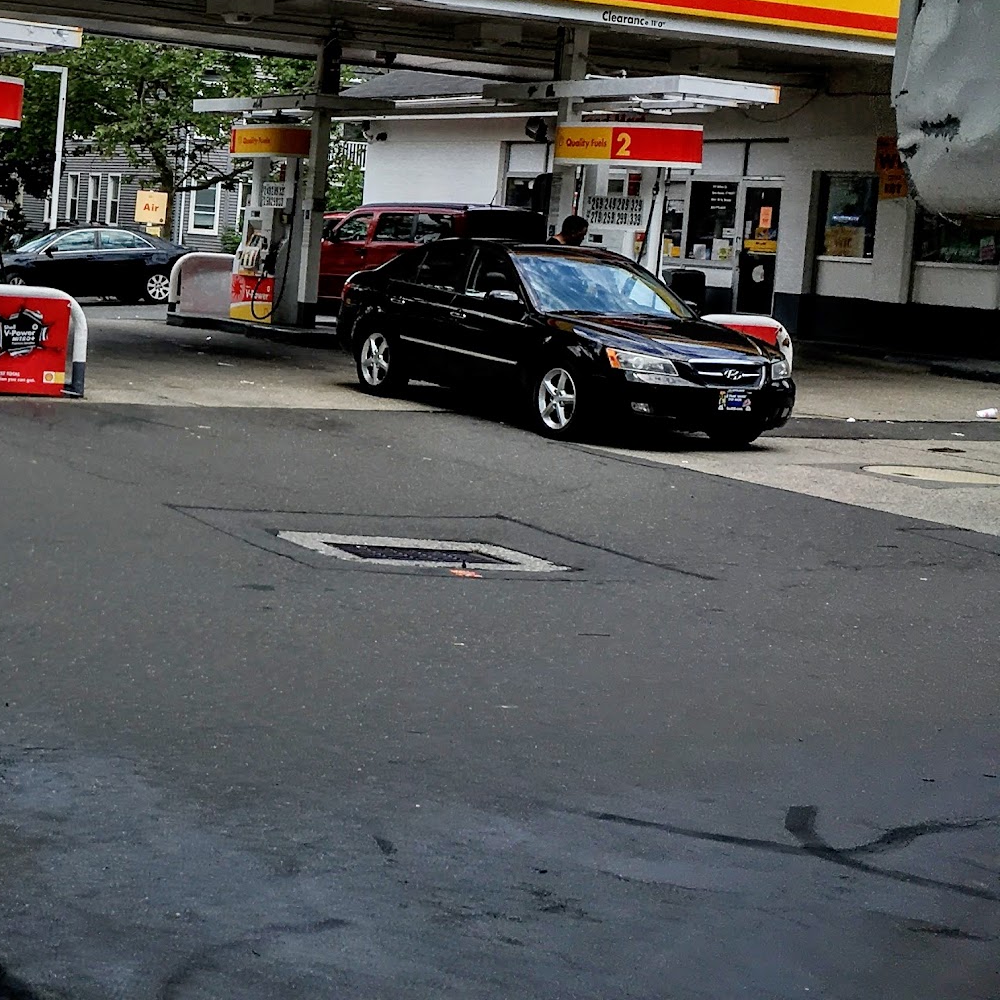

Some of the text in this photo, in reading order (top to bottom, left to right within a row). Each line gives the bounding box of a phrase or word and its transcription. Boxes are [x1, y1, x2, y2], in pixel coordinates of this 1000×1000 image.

[602, 11, 649, 26] Clearance
[566, 138, 607, 149] Quality Fuels
[616, 132, 631, 156] 2
[143, 203, 160, 212] Air
